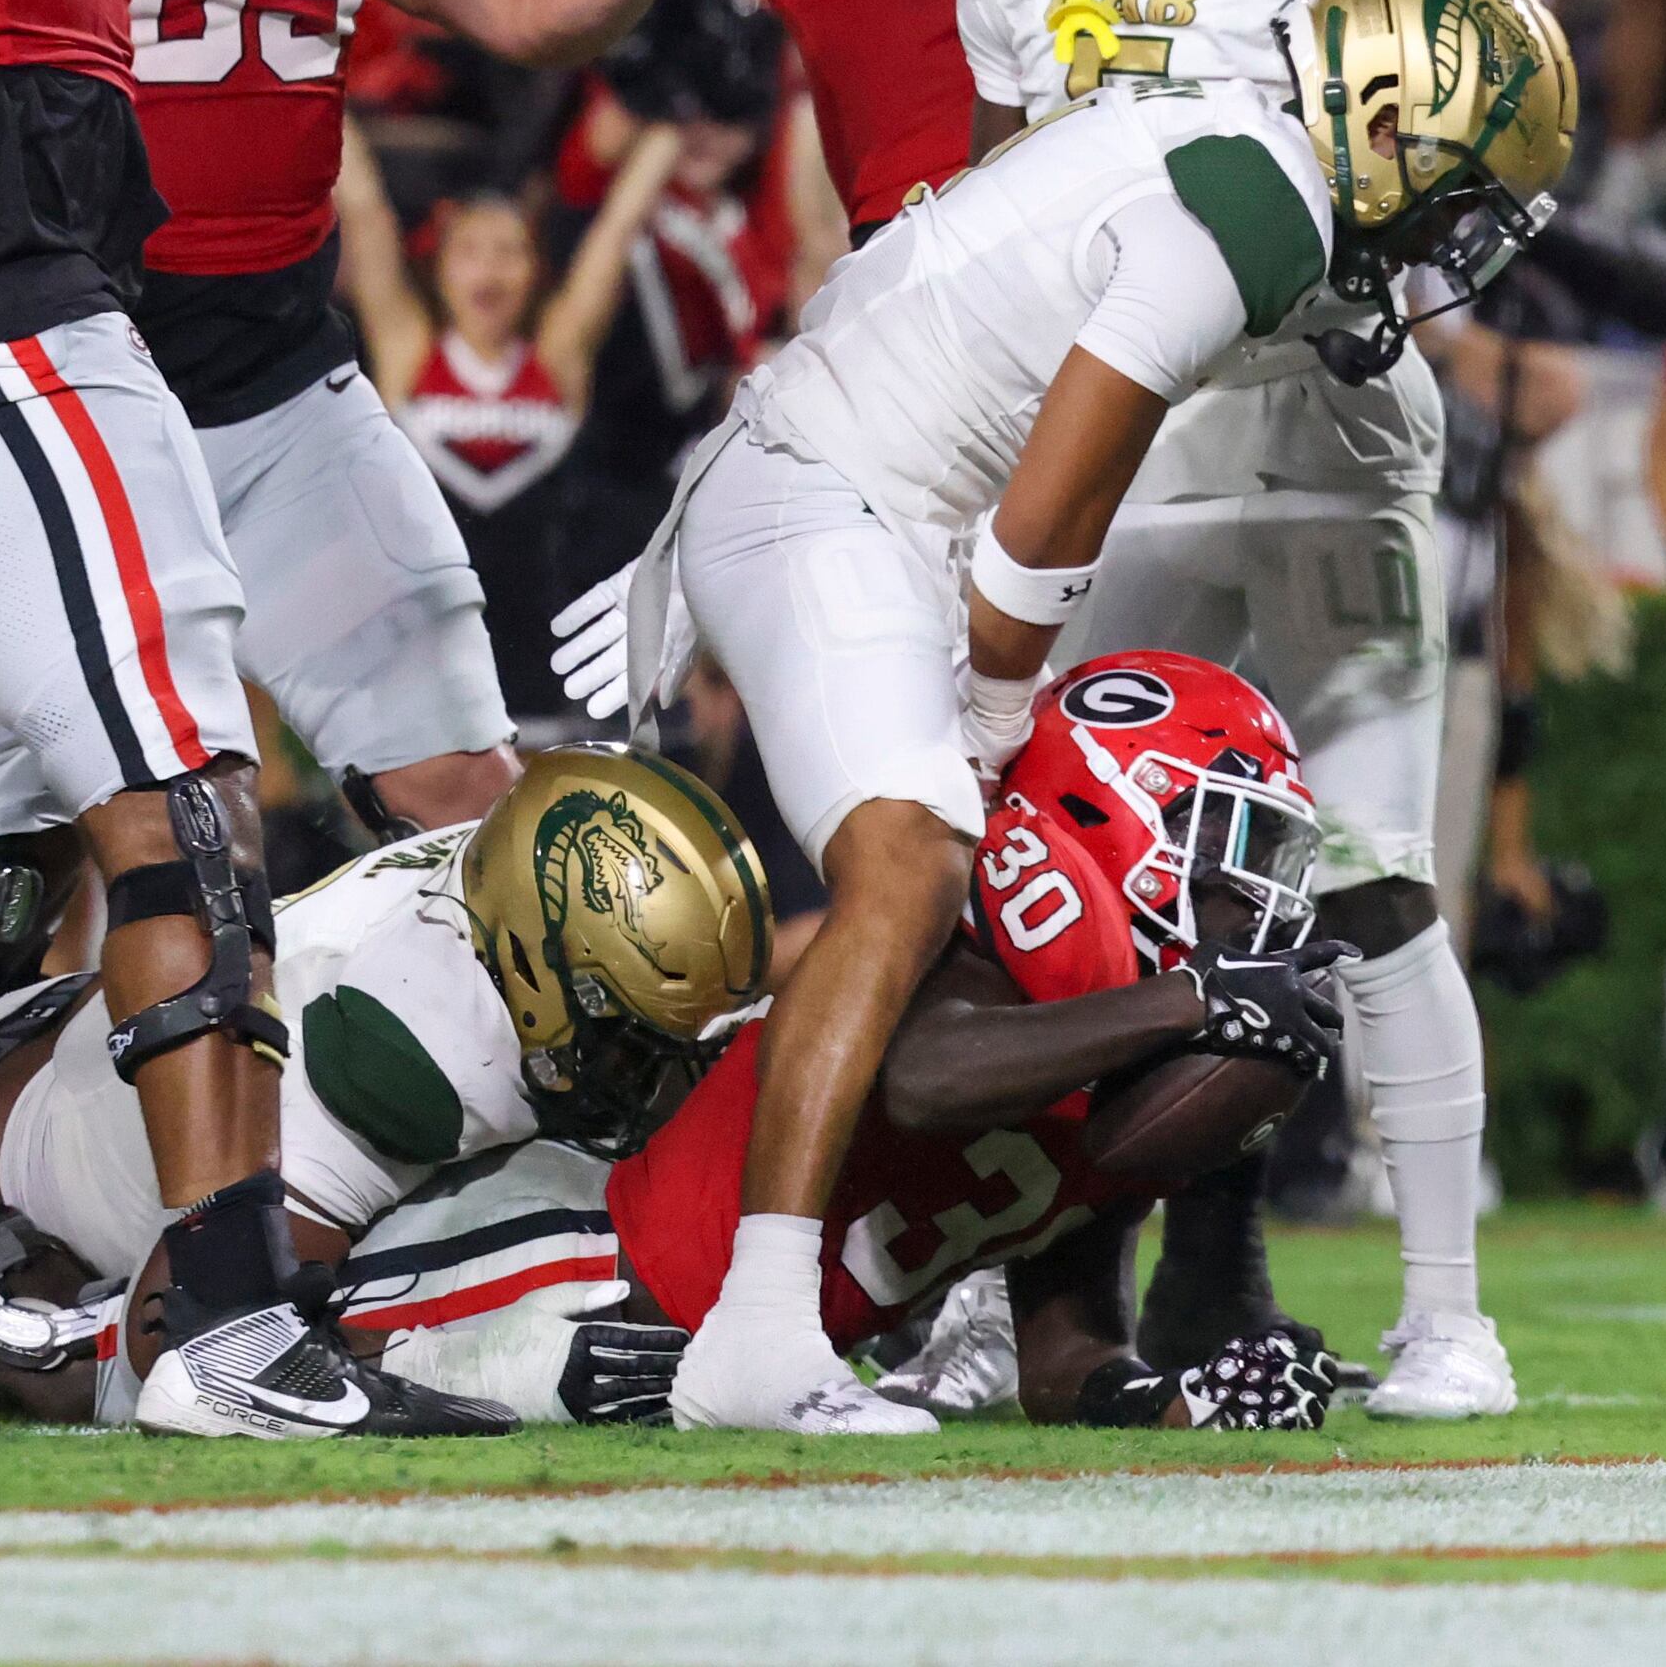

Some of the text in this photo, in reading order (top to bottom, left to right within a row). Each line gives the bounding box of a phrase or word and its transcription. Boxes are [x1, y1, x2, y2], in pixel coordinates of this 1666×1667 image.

[1062, 670, 1174, 728] G
[983, 826, 1084, 953] 30
[841, 1129, 1097, 1322] 3
[194, 1394, 287, 1432] FORCE
